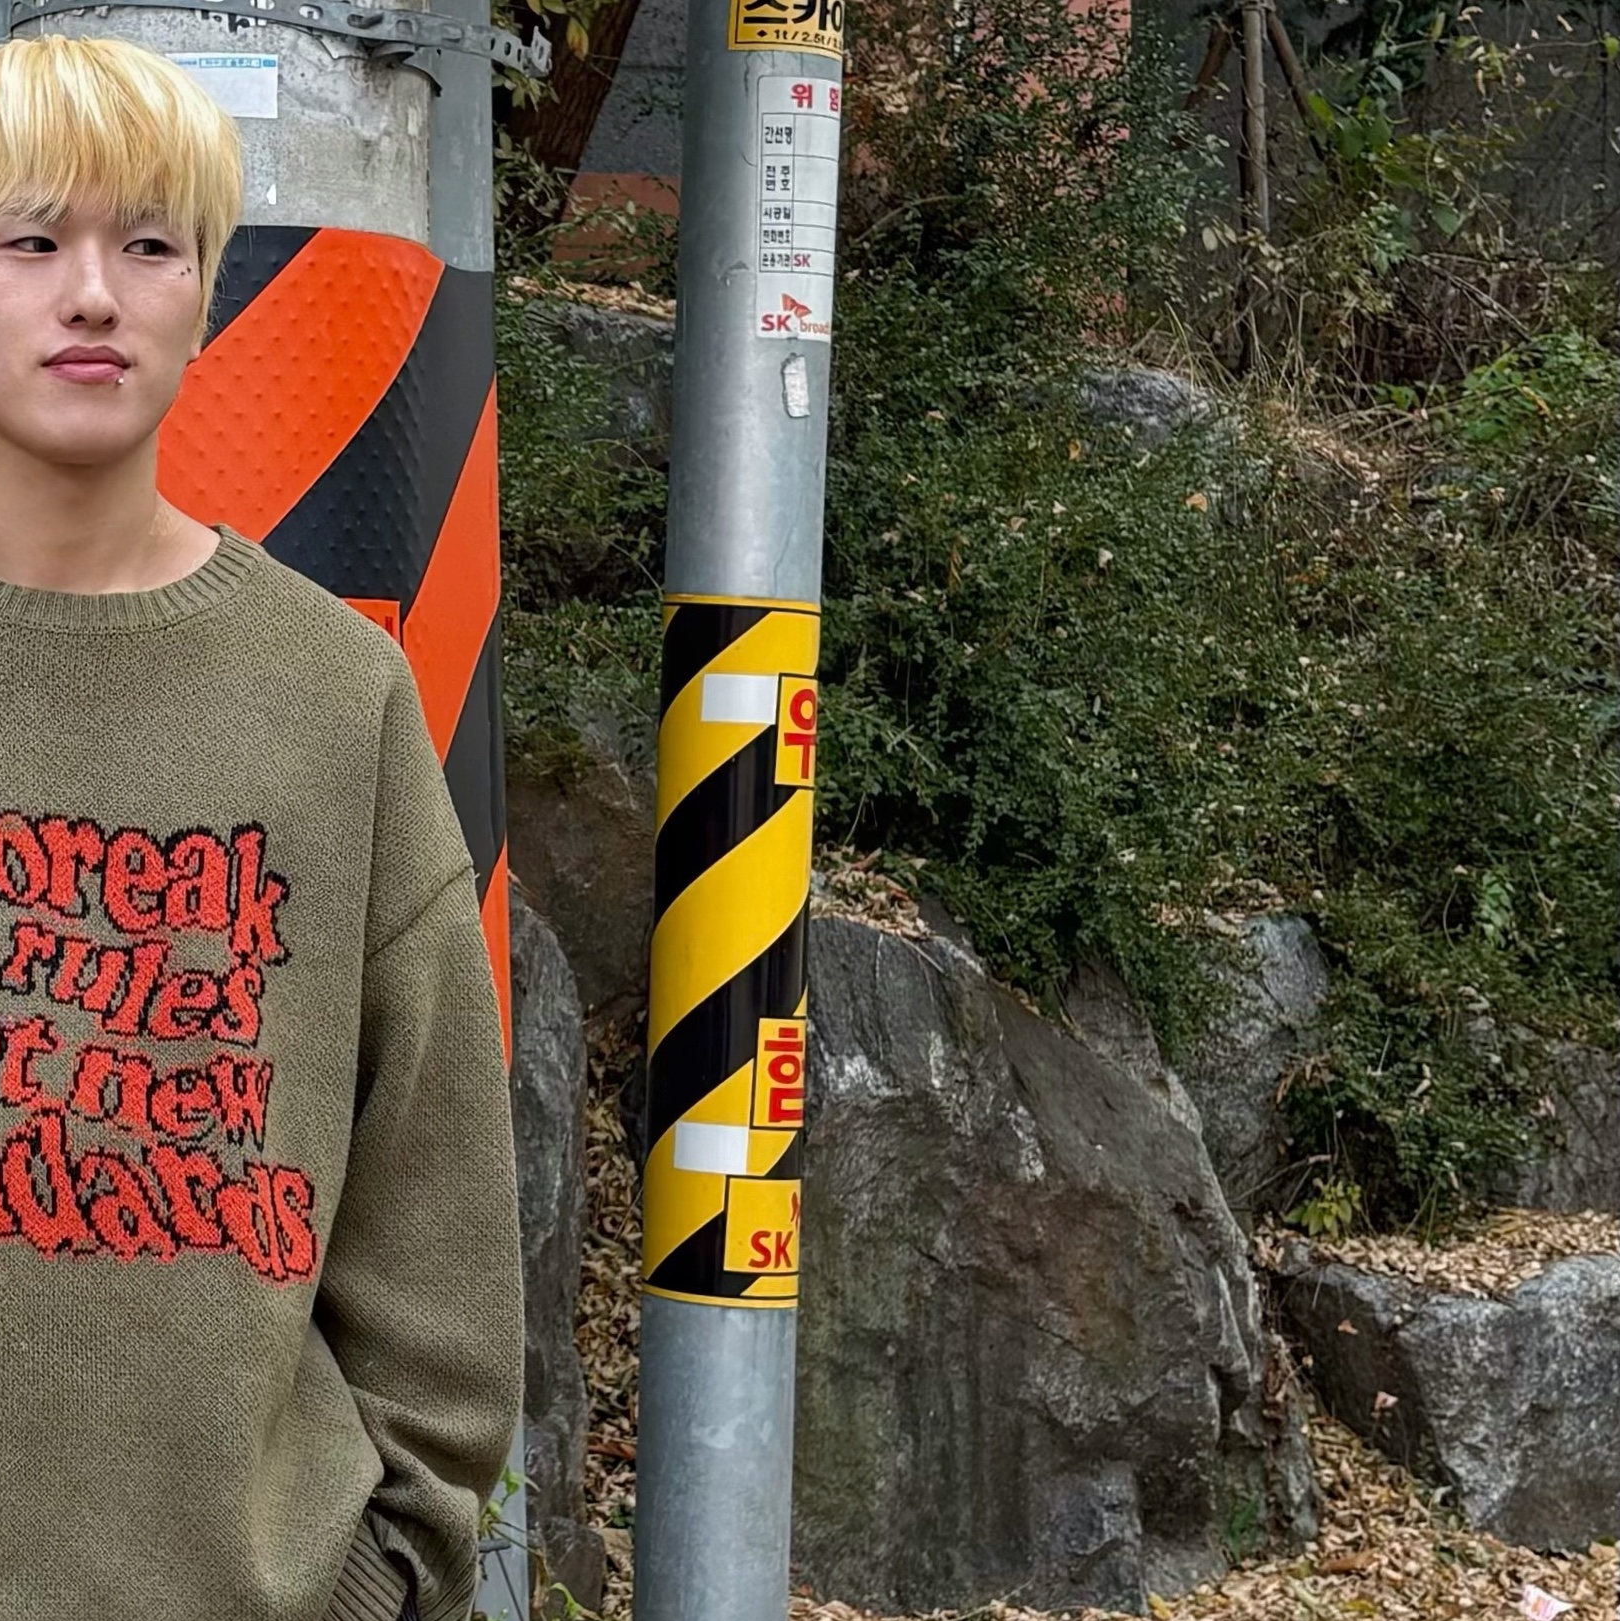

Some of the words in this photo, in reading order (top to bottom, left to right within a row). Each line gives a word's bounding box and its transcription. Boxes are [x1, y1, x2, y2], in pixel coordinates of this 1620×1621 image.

[793, 254, 811, 268] SK
[761, 314, 792, 332] SK
[69, 1042, 273, 1151] new
[748, 1230, 794, 1270] SK
